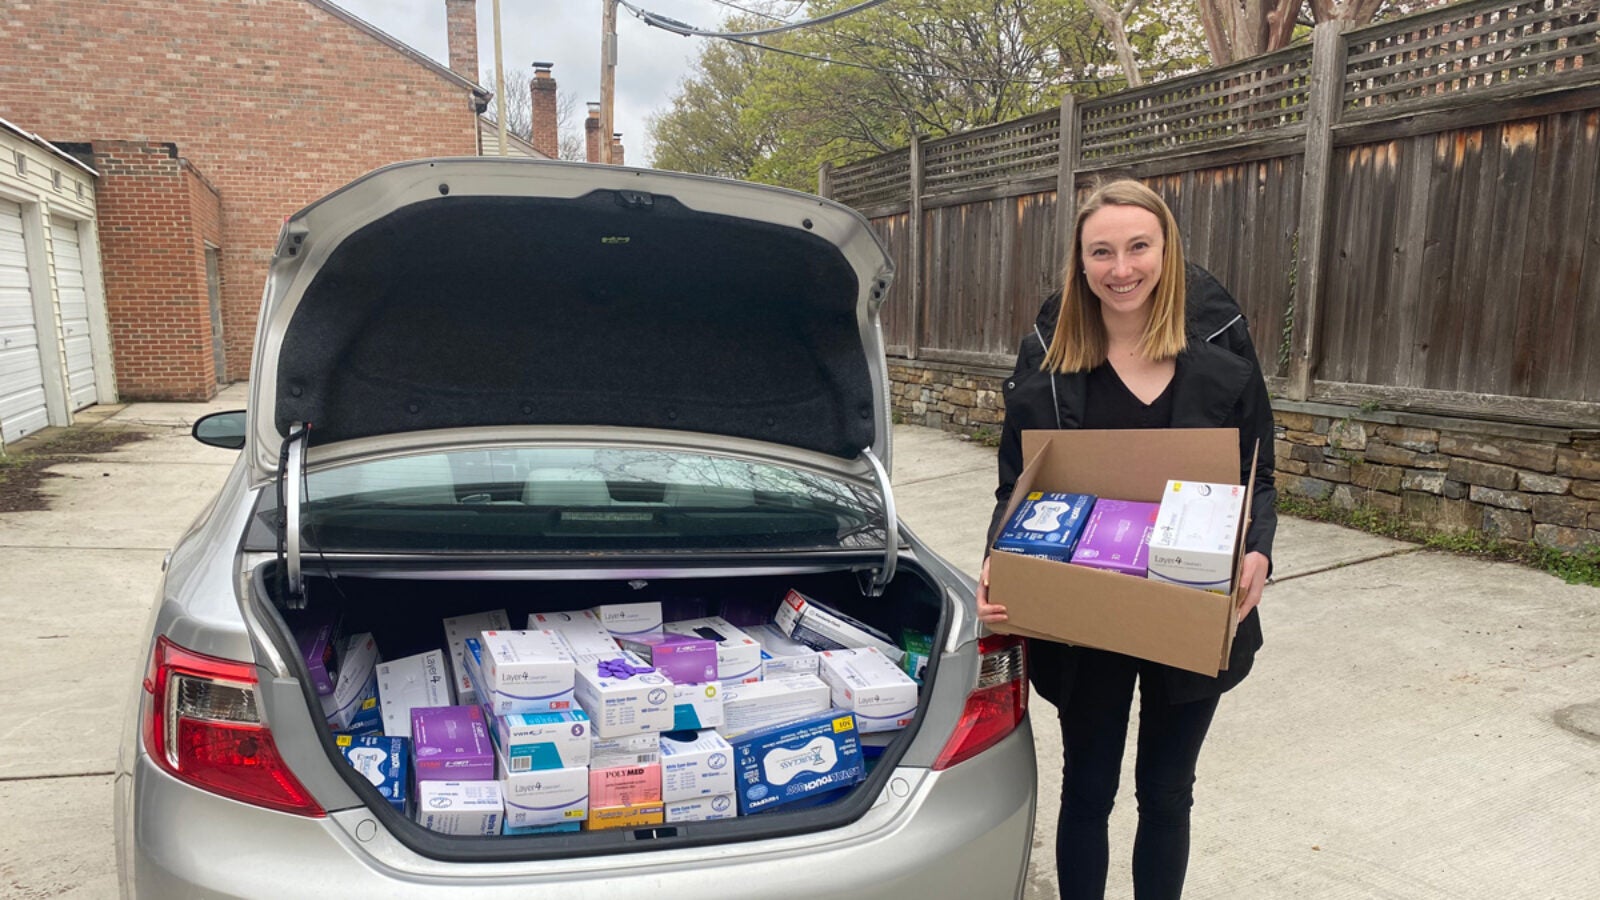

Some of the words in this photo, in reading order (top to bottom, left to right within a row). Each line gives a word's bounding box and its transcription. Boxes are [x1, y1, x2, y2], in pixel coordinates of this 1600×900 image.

[426, 654, 441, 684] Layer4
[502, 671, 529, 683] Layer4
[515, 782, 541, 794] Layer4
